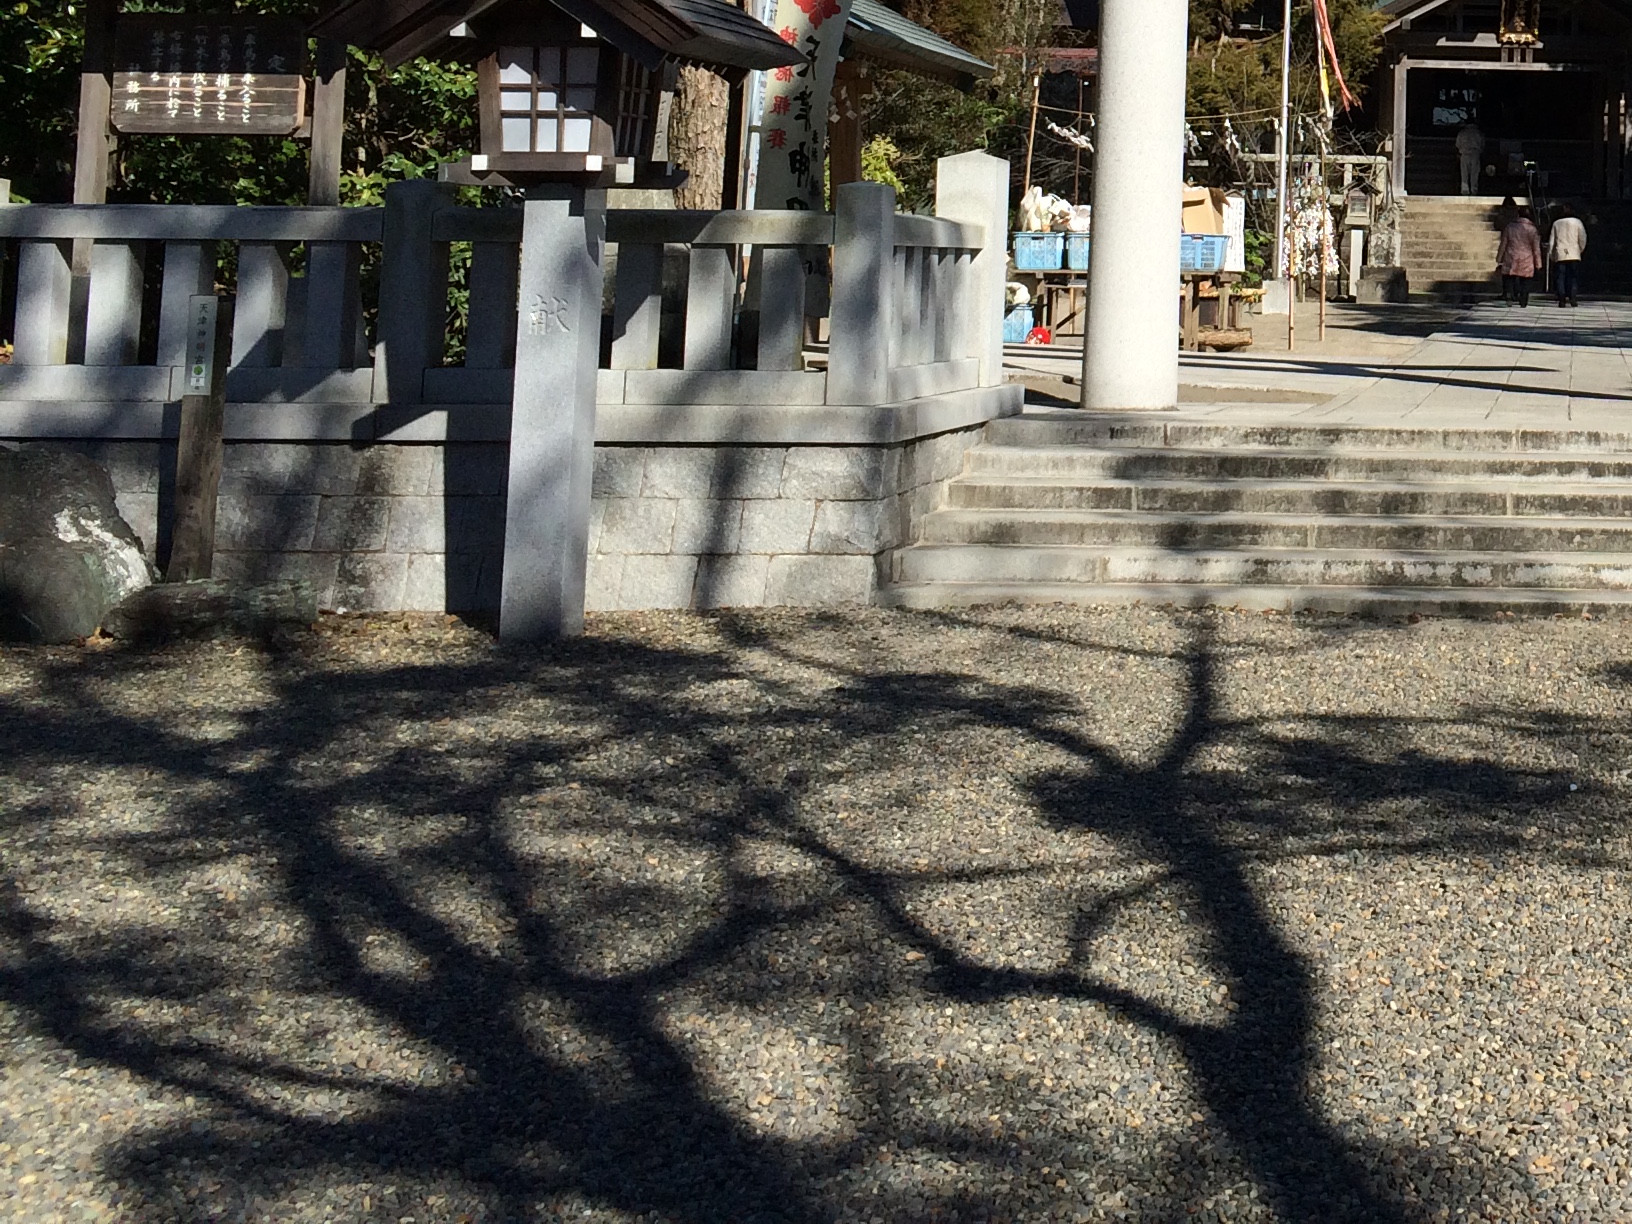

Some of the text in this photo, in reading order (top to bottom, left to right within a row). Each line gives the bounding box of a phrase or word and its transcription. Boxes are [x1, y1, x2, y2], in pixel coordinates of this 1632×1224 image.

[195, 303, 209, 364] 天津神明宮
[528, 293, 571, 335] 献
